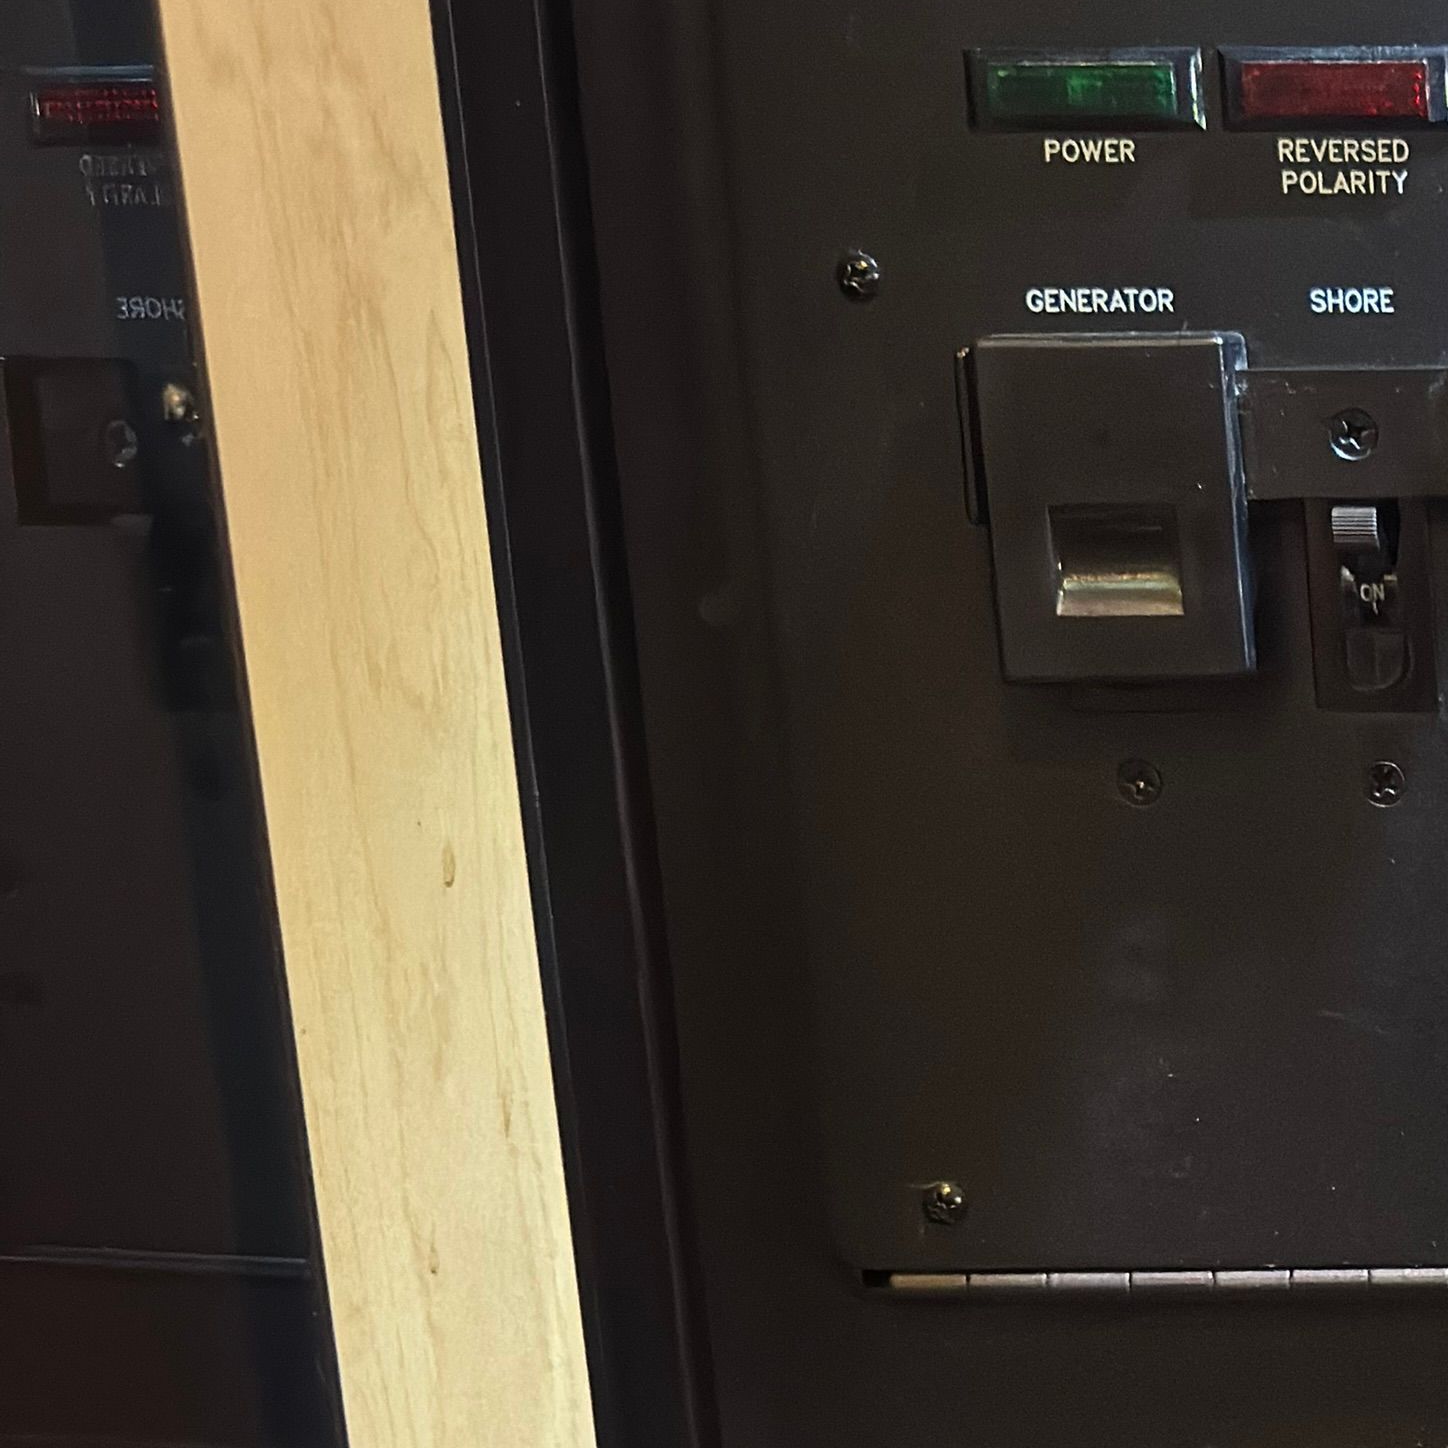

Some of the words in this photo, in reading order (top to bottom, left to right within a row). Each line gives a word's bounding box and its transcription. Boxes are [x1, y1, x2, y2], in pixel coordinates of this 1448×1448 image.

[1045, 139, 1135, 162] POWER
[1278, 139, 1409, 162] REVERSED
[1282, 170, 1407, 194] POLARITY
[1026, 288, 1173, 312] GENERATOR
[1310, 288, 1394, 313] SHORE
